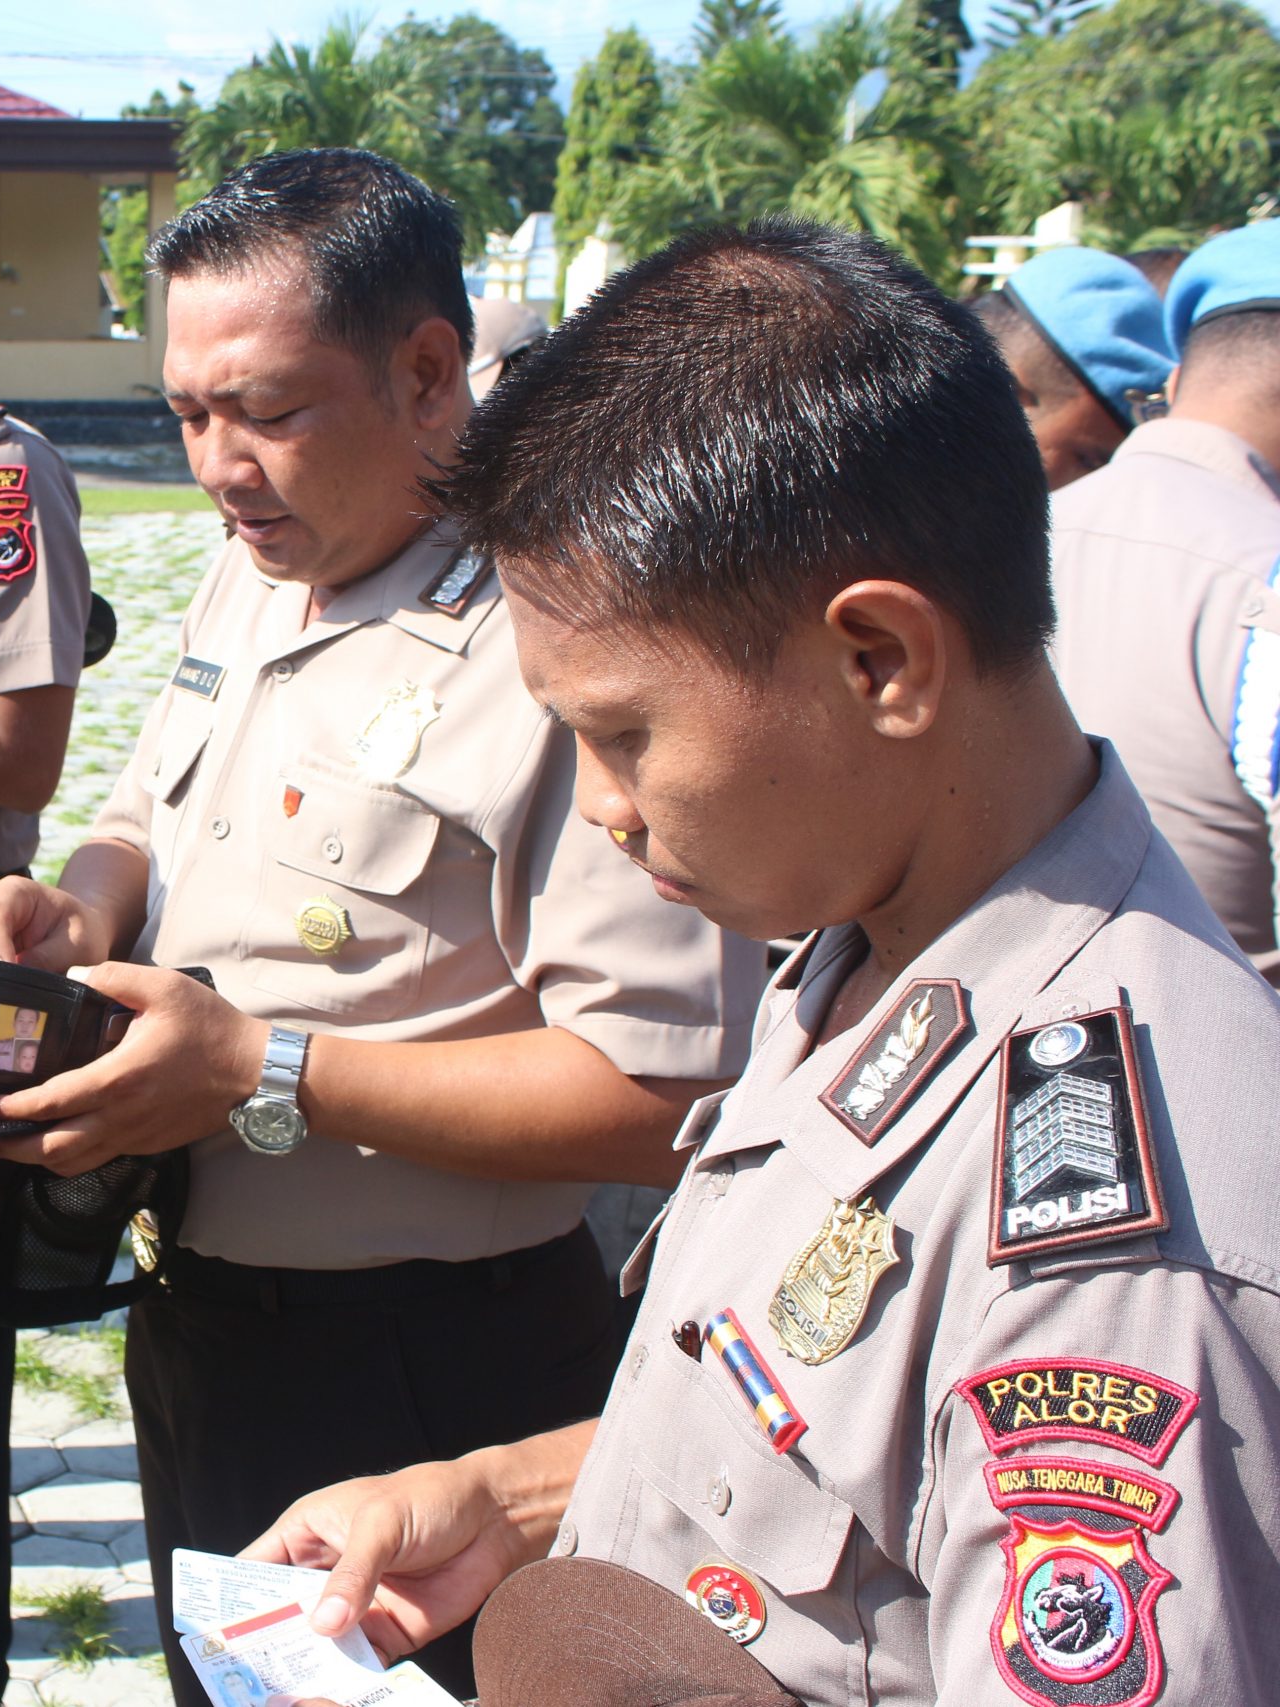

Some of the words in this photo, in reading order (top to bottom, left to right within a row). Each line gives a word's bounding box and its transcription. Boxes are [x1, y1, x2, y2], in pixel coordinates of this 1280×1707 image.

[1006, 1182, 1130, 1236] POLISI
[778, 1288, 820, 1340] POLISI
[986, 1370, 1158, 1412] POLRES
[1013, 1398, 1130, 1433] ALOR
[996, 1469, 1028, 1494] NUSA
[1031, 1468, 1105, 1496] TENGGARA
[1112, 1479, 1157, 1514] TIMUR
